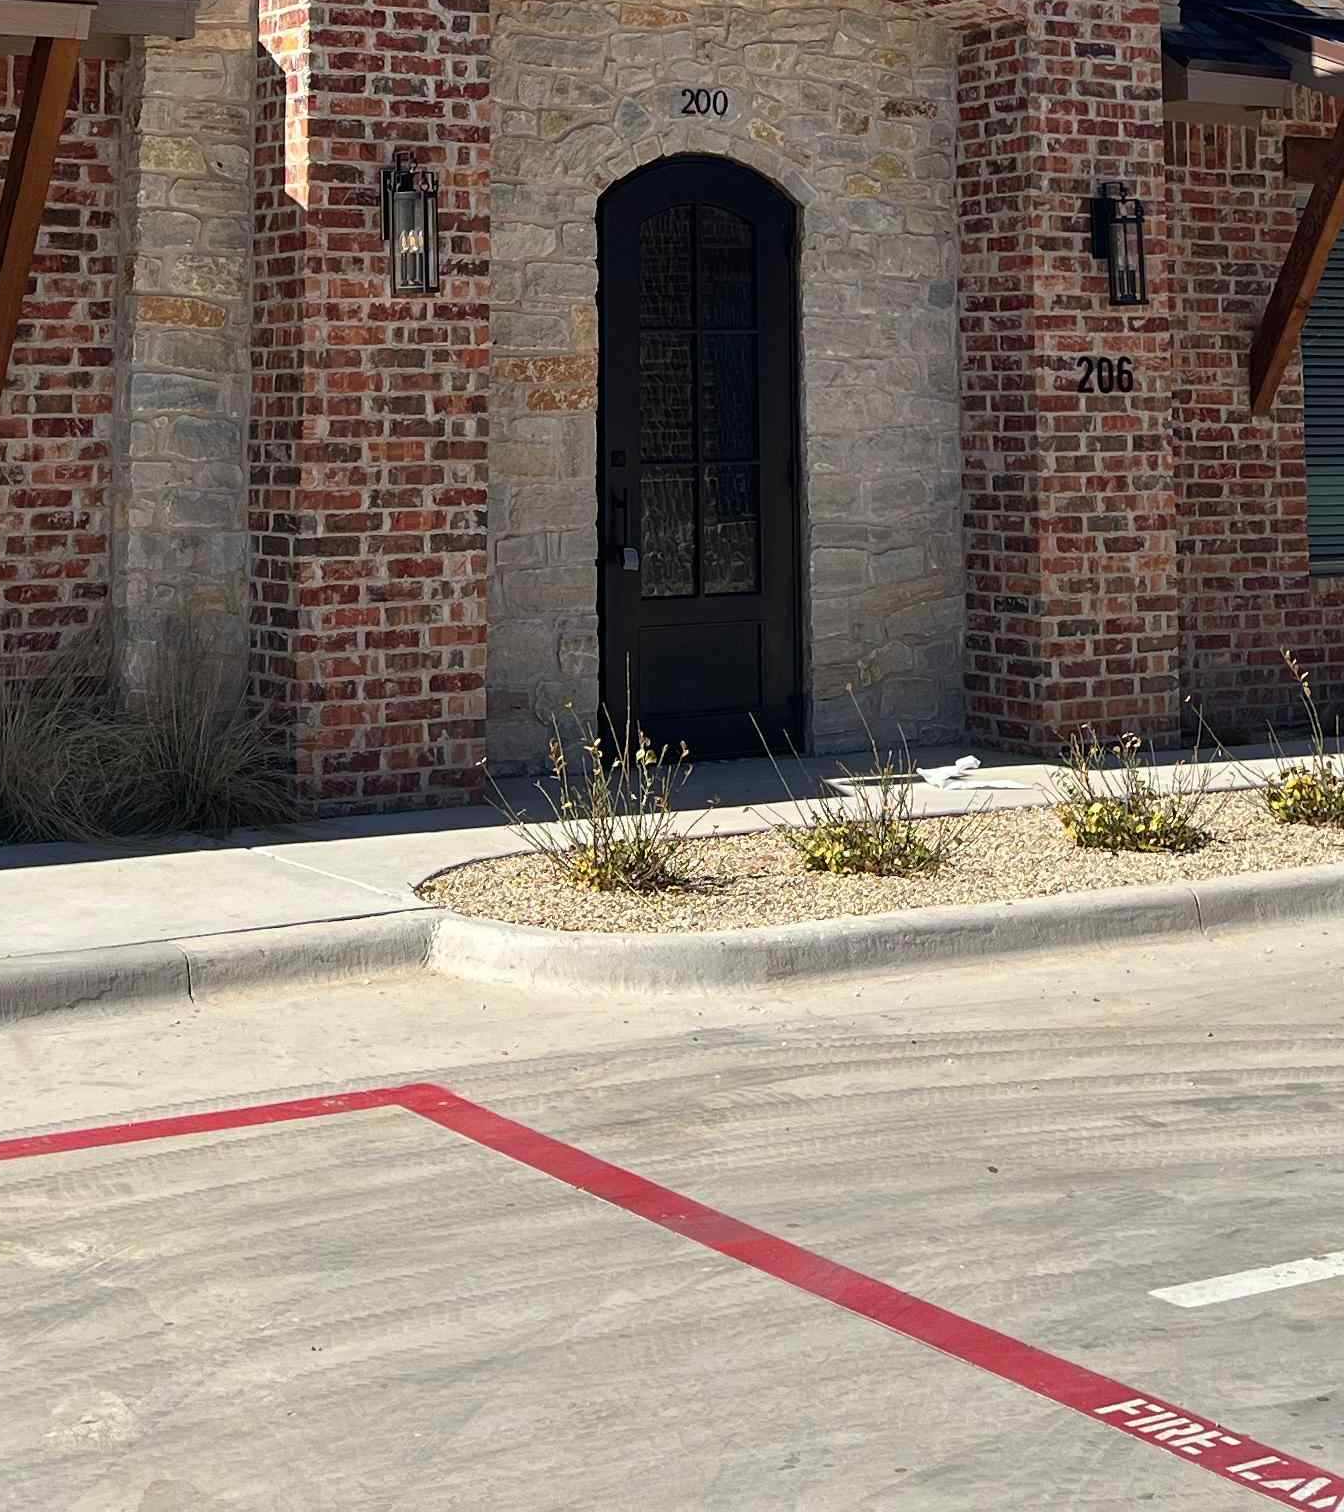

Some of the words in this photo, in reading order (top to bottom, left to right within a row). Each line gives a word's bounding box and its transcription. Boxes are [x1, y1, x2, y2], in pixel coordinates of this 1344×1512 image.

[681, 88, 729, 116] 200
[1076, 355, 1134, 394] 206
[1093, 1398, 1242, 1456] FIRE
